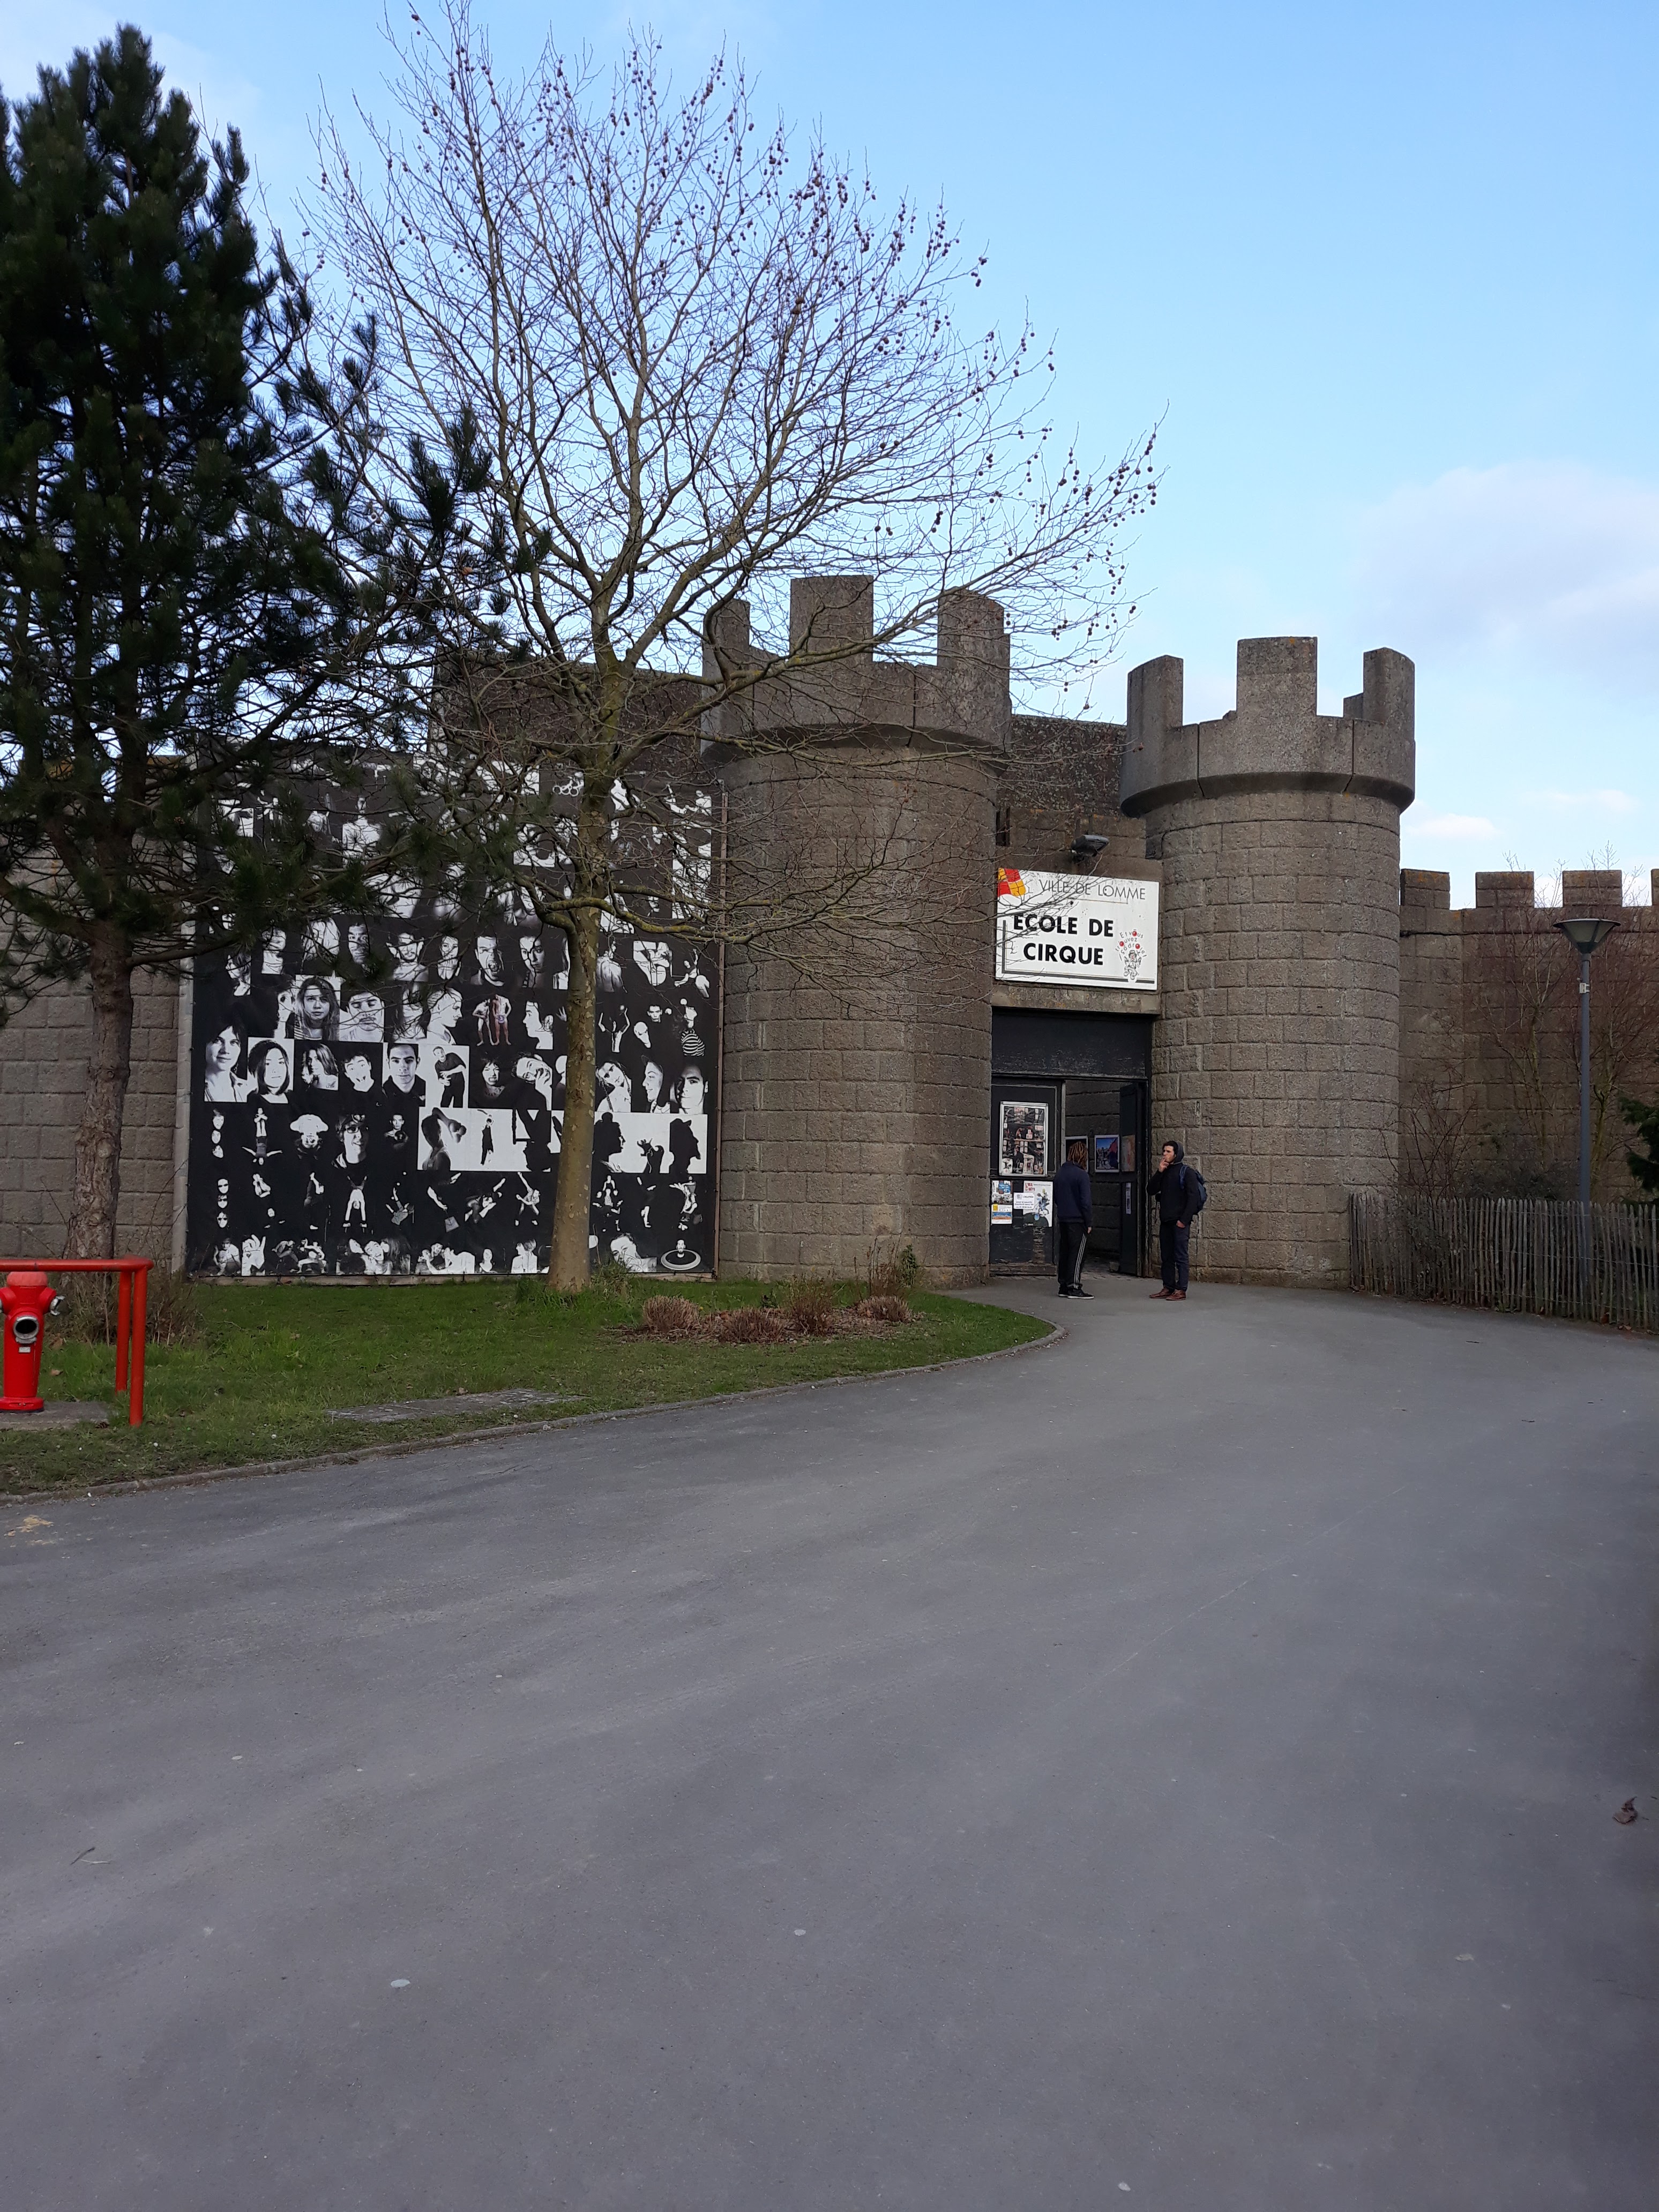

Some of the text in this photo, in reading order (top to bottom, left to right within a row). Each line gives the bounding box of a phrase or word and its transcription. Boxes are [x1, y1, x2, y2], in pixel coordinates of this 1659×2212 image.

[1038, 879, 1146, 900] VILLE DE LOMME
[1014, 913, 1114, 937] ECOLE DE
[1023, 943, 1103, 965] CIRQUE
